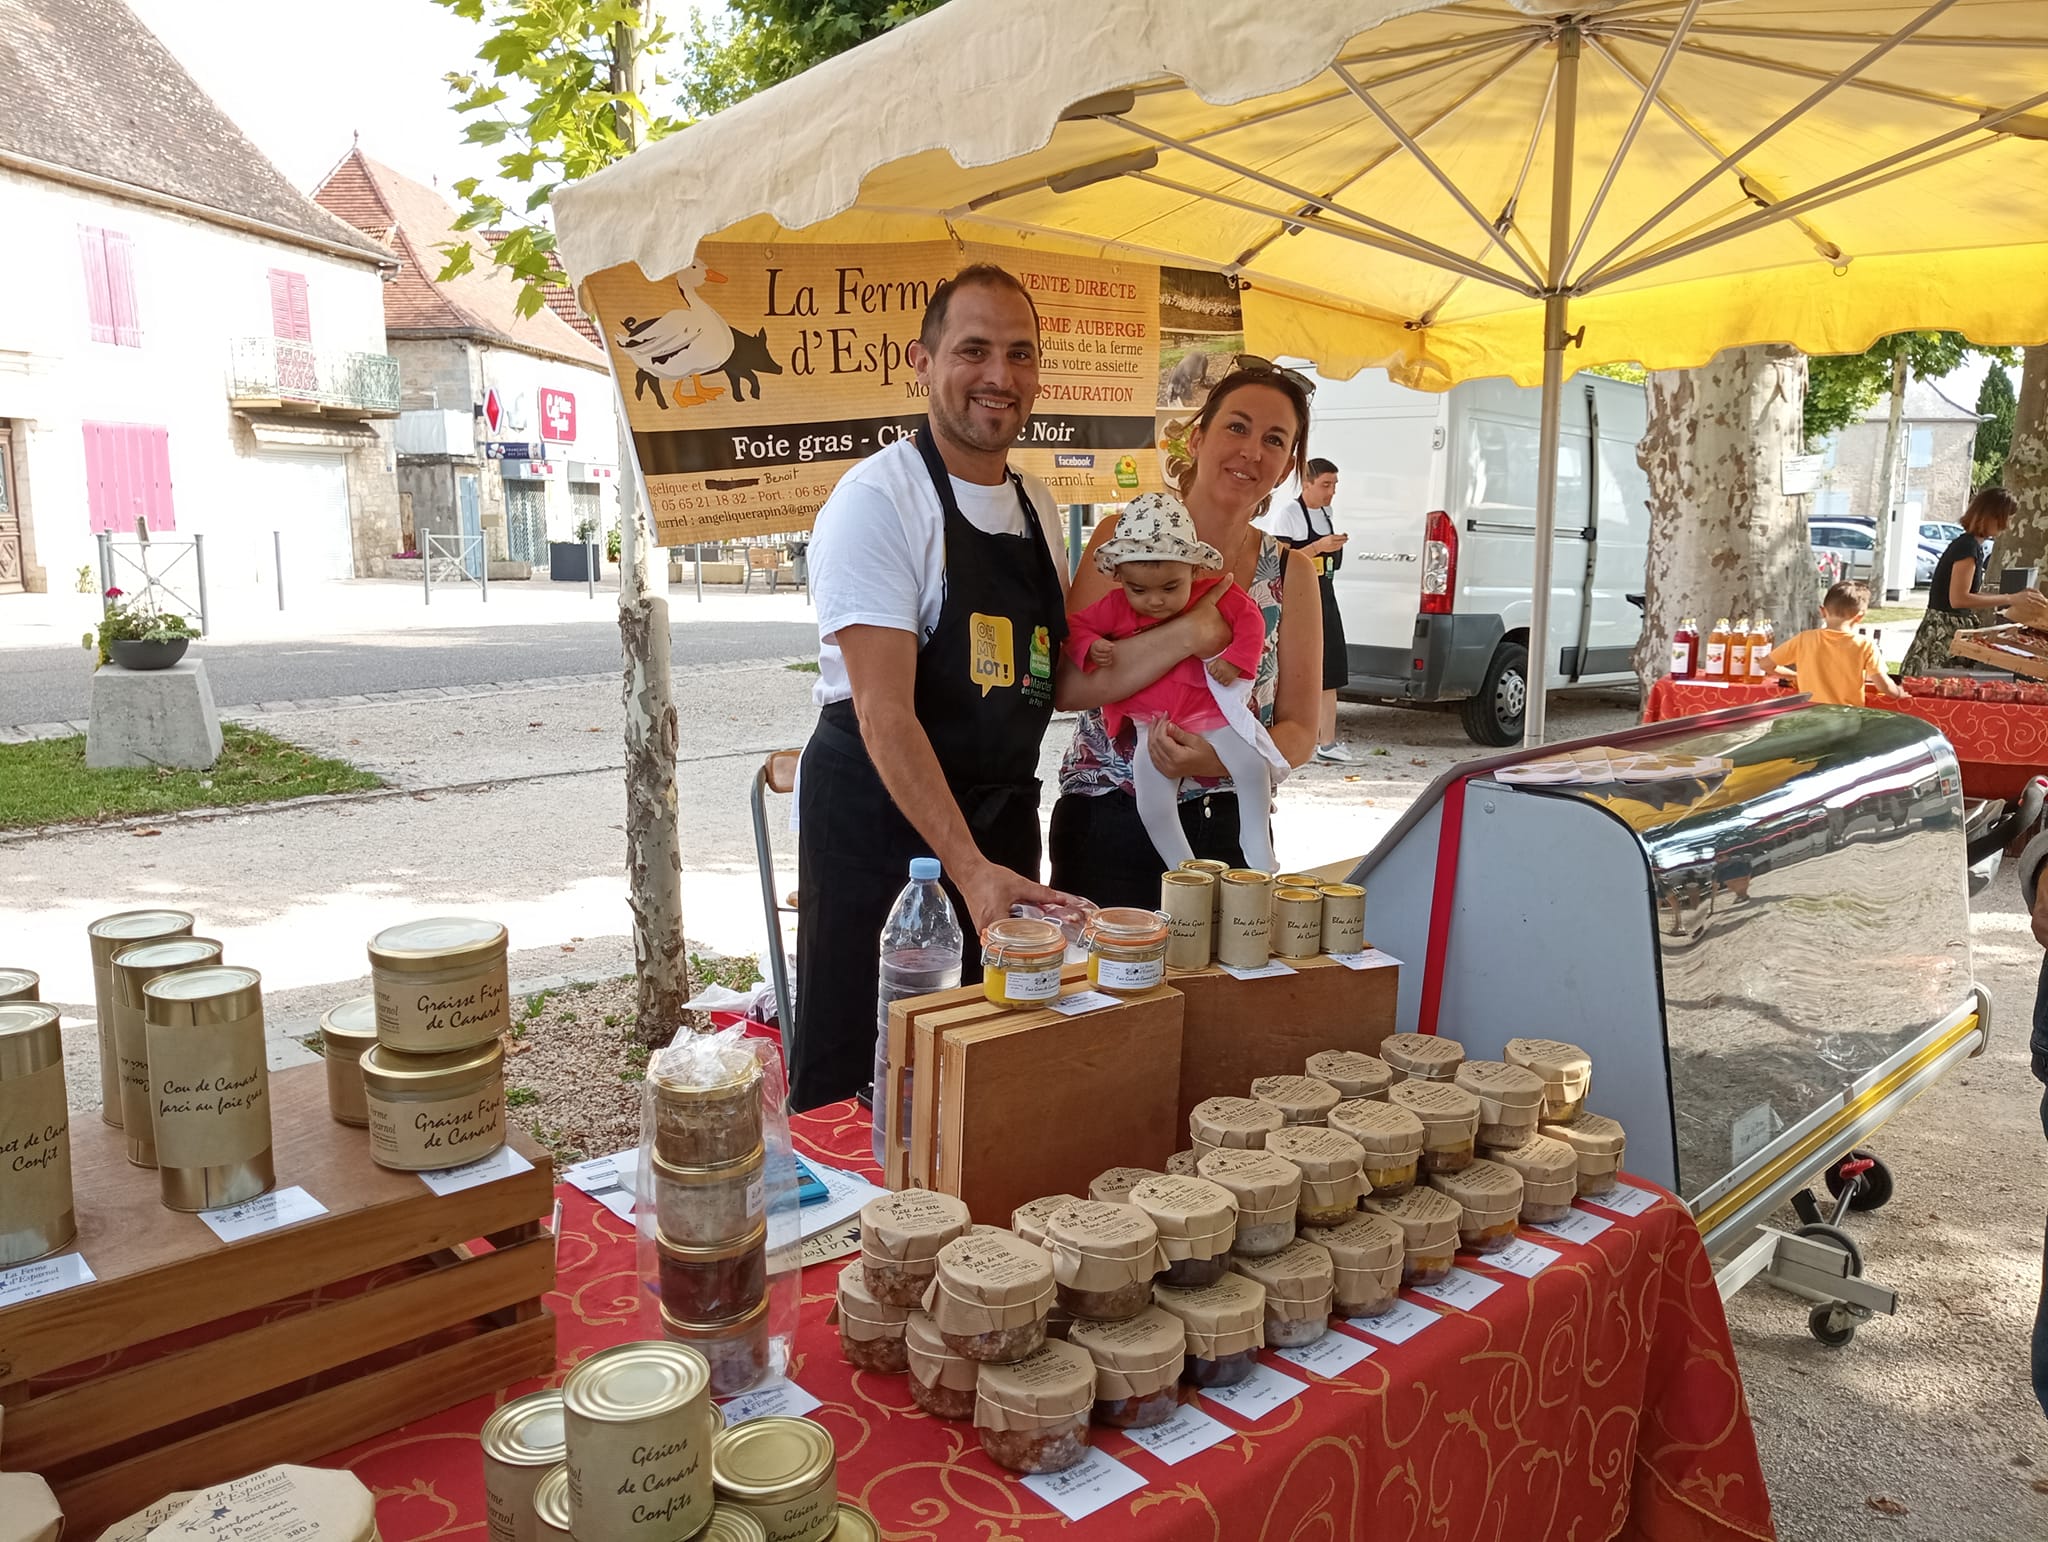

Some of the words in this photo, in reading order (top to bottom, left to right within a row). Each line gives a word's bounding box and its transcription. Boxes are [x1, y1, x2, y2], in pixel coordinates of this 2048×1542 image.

[764, 268, 819, 317] La
[1020, 272, 1070, 293] VENTE
[1075, 279, 1136, 299] DIRECTE
[1040, 316, 1071, 333] RME
[1075, 320, 1146, 338] AUBERGE
[1040, 337, 1075, 351] oduits
[1078, 339, 1091, 352] de
[1095, 340, 1106, 354] la
[1110, 341, 1143, 356] ferme
[1039, 358, 1058, 369] ns
[1062, 360, 1092, 371] votre
[1095, 360, 1138, 373] assiette
[906, 381, 930, 398] Mo
[732, 434, 790, 460] Foie
[799, 434, 852, 462] gras
[877, 425, 918, 448] Ch
[1031, 422, 1075, 442] Noir
[1058, 456, 1091, 467] facebook
[648, 481, 688, 498] ngélique
[691, 480, 704, 492] et
[661, 500, 676, 512] 05
[679, 498, 693, 510] 65
[696, 498, 711, 509] 21
[716, 495, 729, 506] 18
[732, 493, 747, 505] 32
[758, 490, 785, 503] Port.
[795, 487, 810, 498] 06
[813, 485, 828, 496] 85
[976, 622, 995, 642] OH
[976, 640, 998, 658] MY
[976, 658, 1000, 677] LOT
[417, 994, 475, 1014] Graisse
[480, 984, 503, 1001] Fine
[426, 1015, 445, 1031] de
[449, 999, 501, 1028] Canard
[163, 1080, 191, 1094] Cou
[195, 1078, 210, 1092] de
[215, 1066, 258, 1091] Canard
[160, 1099, 191, 1117] farci
[195, 1103, 213, 1112] au
[218, 1097, 243, 1115] foie
[415, 1111, 474, 1131] Graisse
[478, 1097, 501, 1118] Fine
[24, 1133, 40, 1150] de
[44, 1123, 67, 1142] Can
[424, 1132, 443, 1149] de
[447, 1118, 497, 1146] Canard
[12, 1146, 58, 1172] Confit
[632, 1438, 689, 1467] Gésiers
[617, 1478, 636, 1495] de
[643, 1450, 699, 1493] Canard
[206, 1490, 224, 1501] La
[230, 1472, 269, 1491] Ferme
[215, 1471, 287, 1507] d'Esparnol
[146, 1509, 161, 1518] La
[209, 1500, 289, 1535] Jambonneau
[233, 1520, 265, 1536] Porc
[269, 1506, 298, 1521] noir
[632, 1493, 692, 1524] Confits
[784, 1502, 818, 1523] Gésiers
[811, 1504, 834, 1529] Conf
[285, 1526, 308, 1539] 380
[310, 1521, 320, 1529] g
